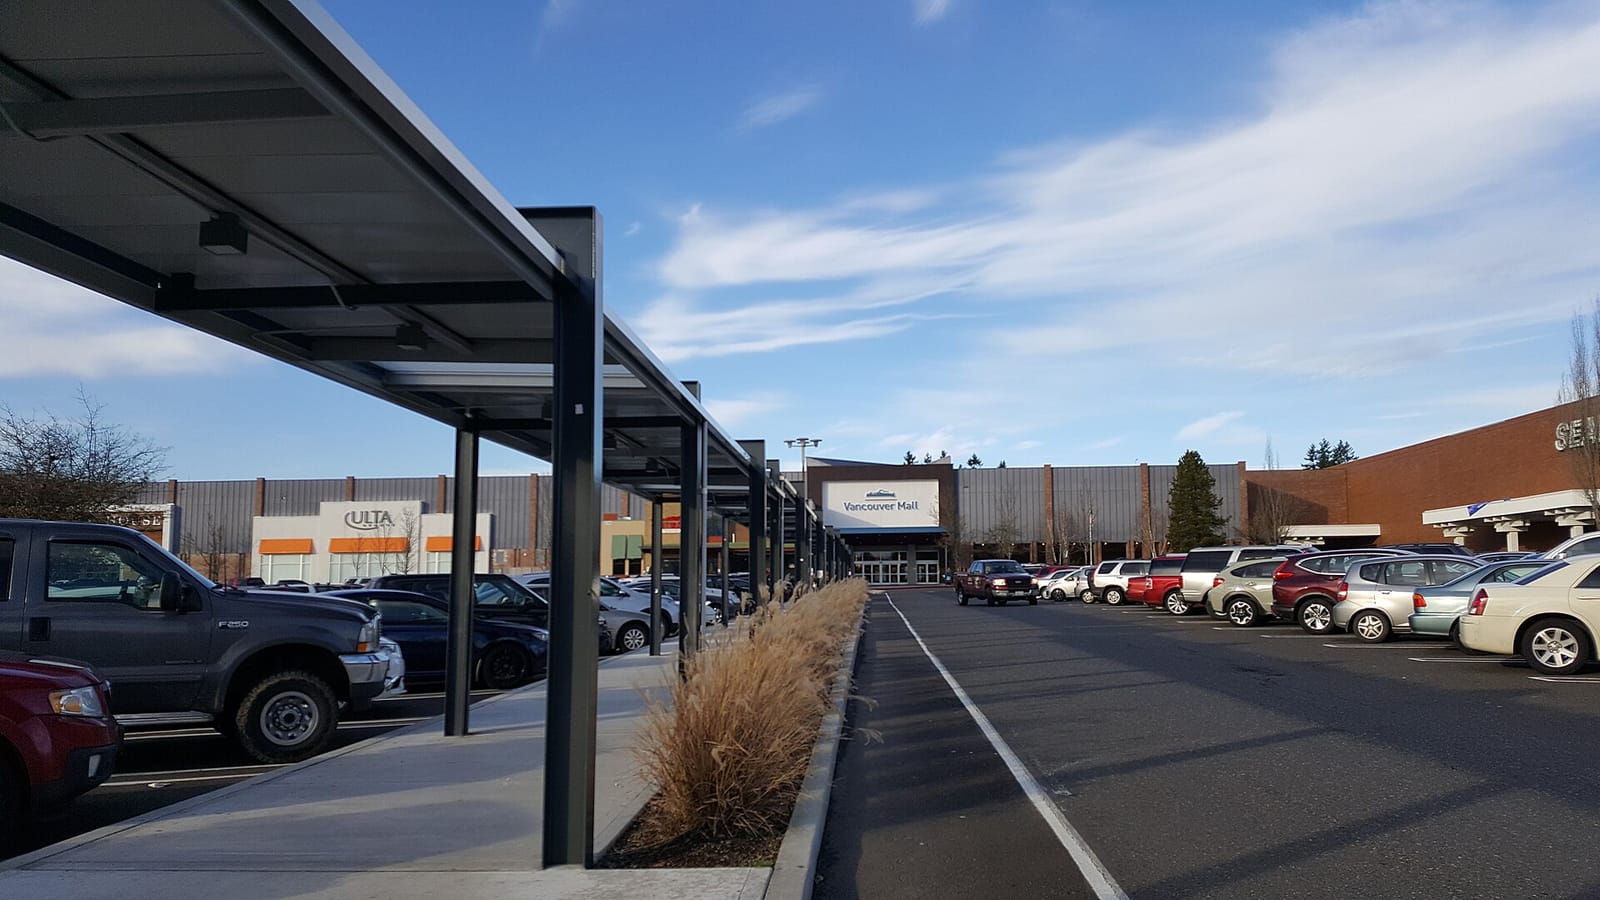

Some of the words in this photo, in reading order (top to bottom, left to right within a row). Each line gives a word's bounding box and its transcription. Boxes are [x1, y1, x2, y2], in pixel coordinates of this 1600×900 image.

[1554, 416, 1600, 451] SEA
[843, 502, 895, 511] Vancouver
[897, 501, 919, 510] Mall
[351, 510, 393, 525] ULTA
